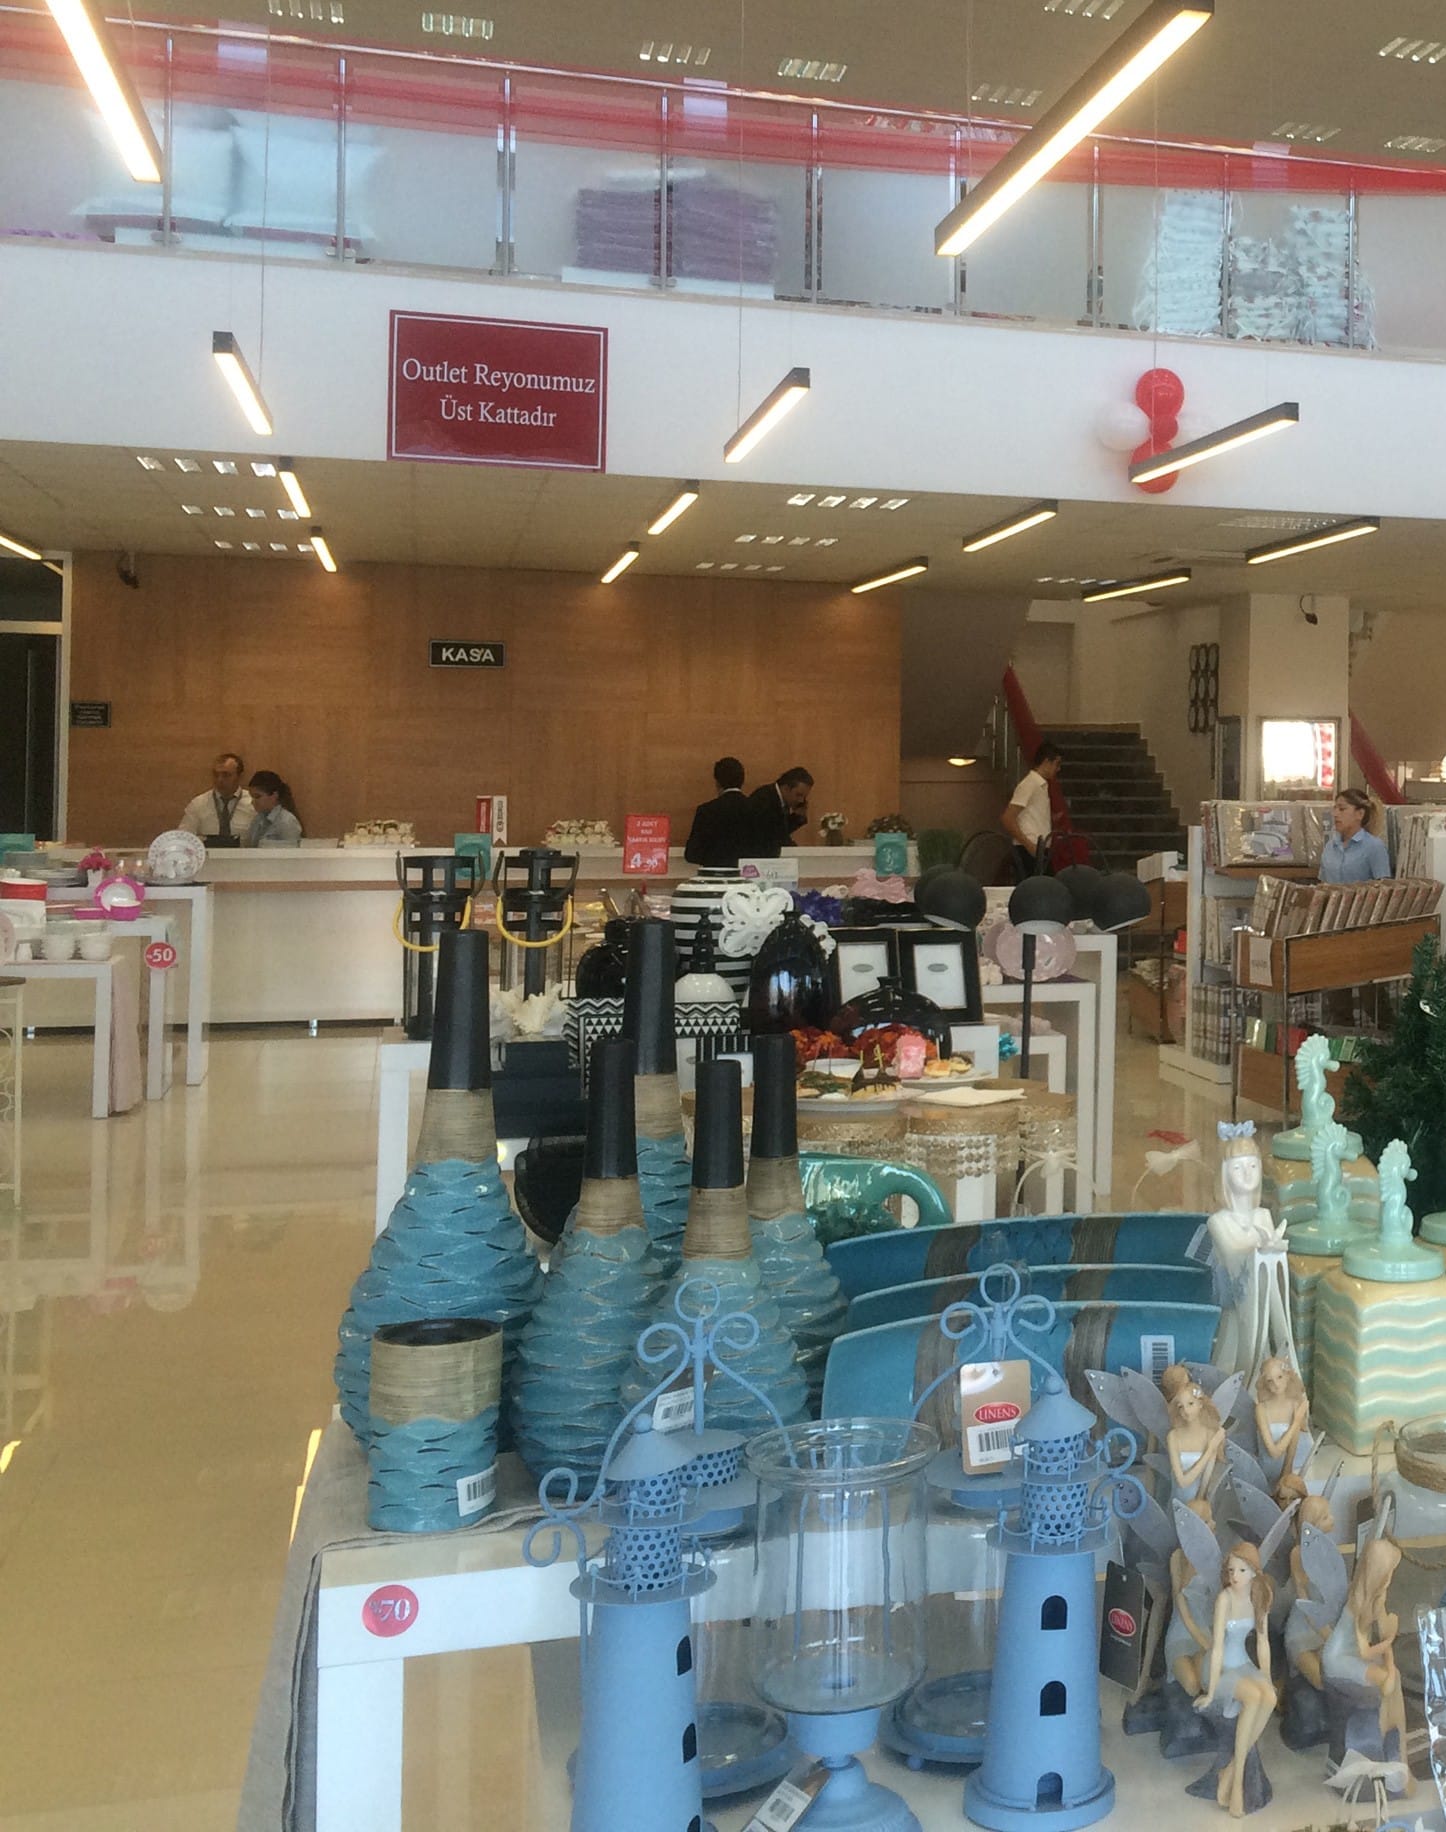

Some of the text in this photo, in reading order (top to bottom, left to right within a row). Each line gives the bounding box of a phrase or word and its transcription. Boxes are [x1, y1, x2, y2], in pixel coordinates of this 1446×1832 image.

[402, 358, 595, 393] Outlet Reyonumuz
[440, 395, 557, 427] Üst Kattadır
[442, 647, 495, 662] KASA
[978, 1407, 1017, 1421] LINENS
